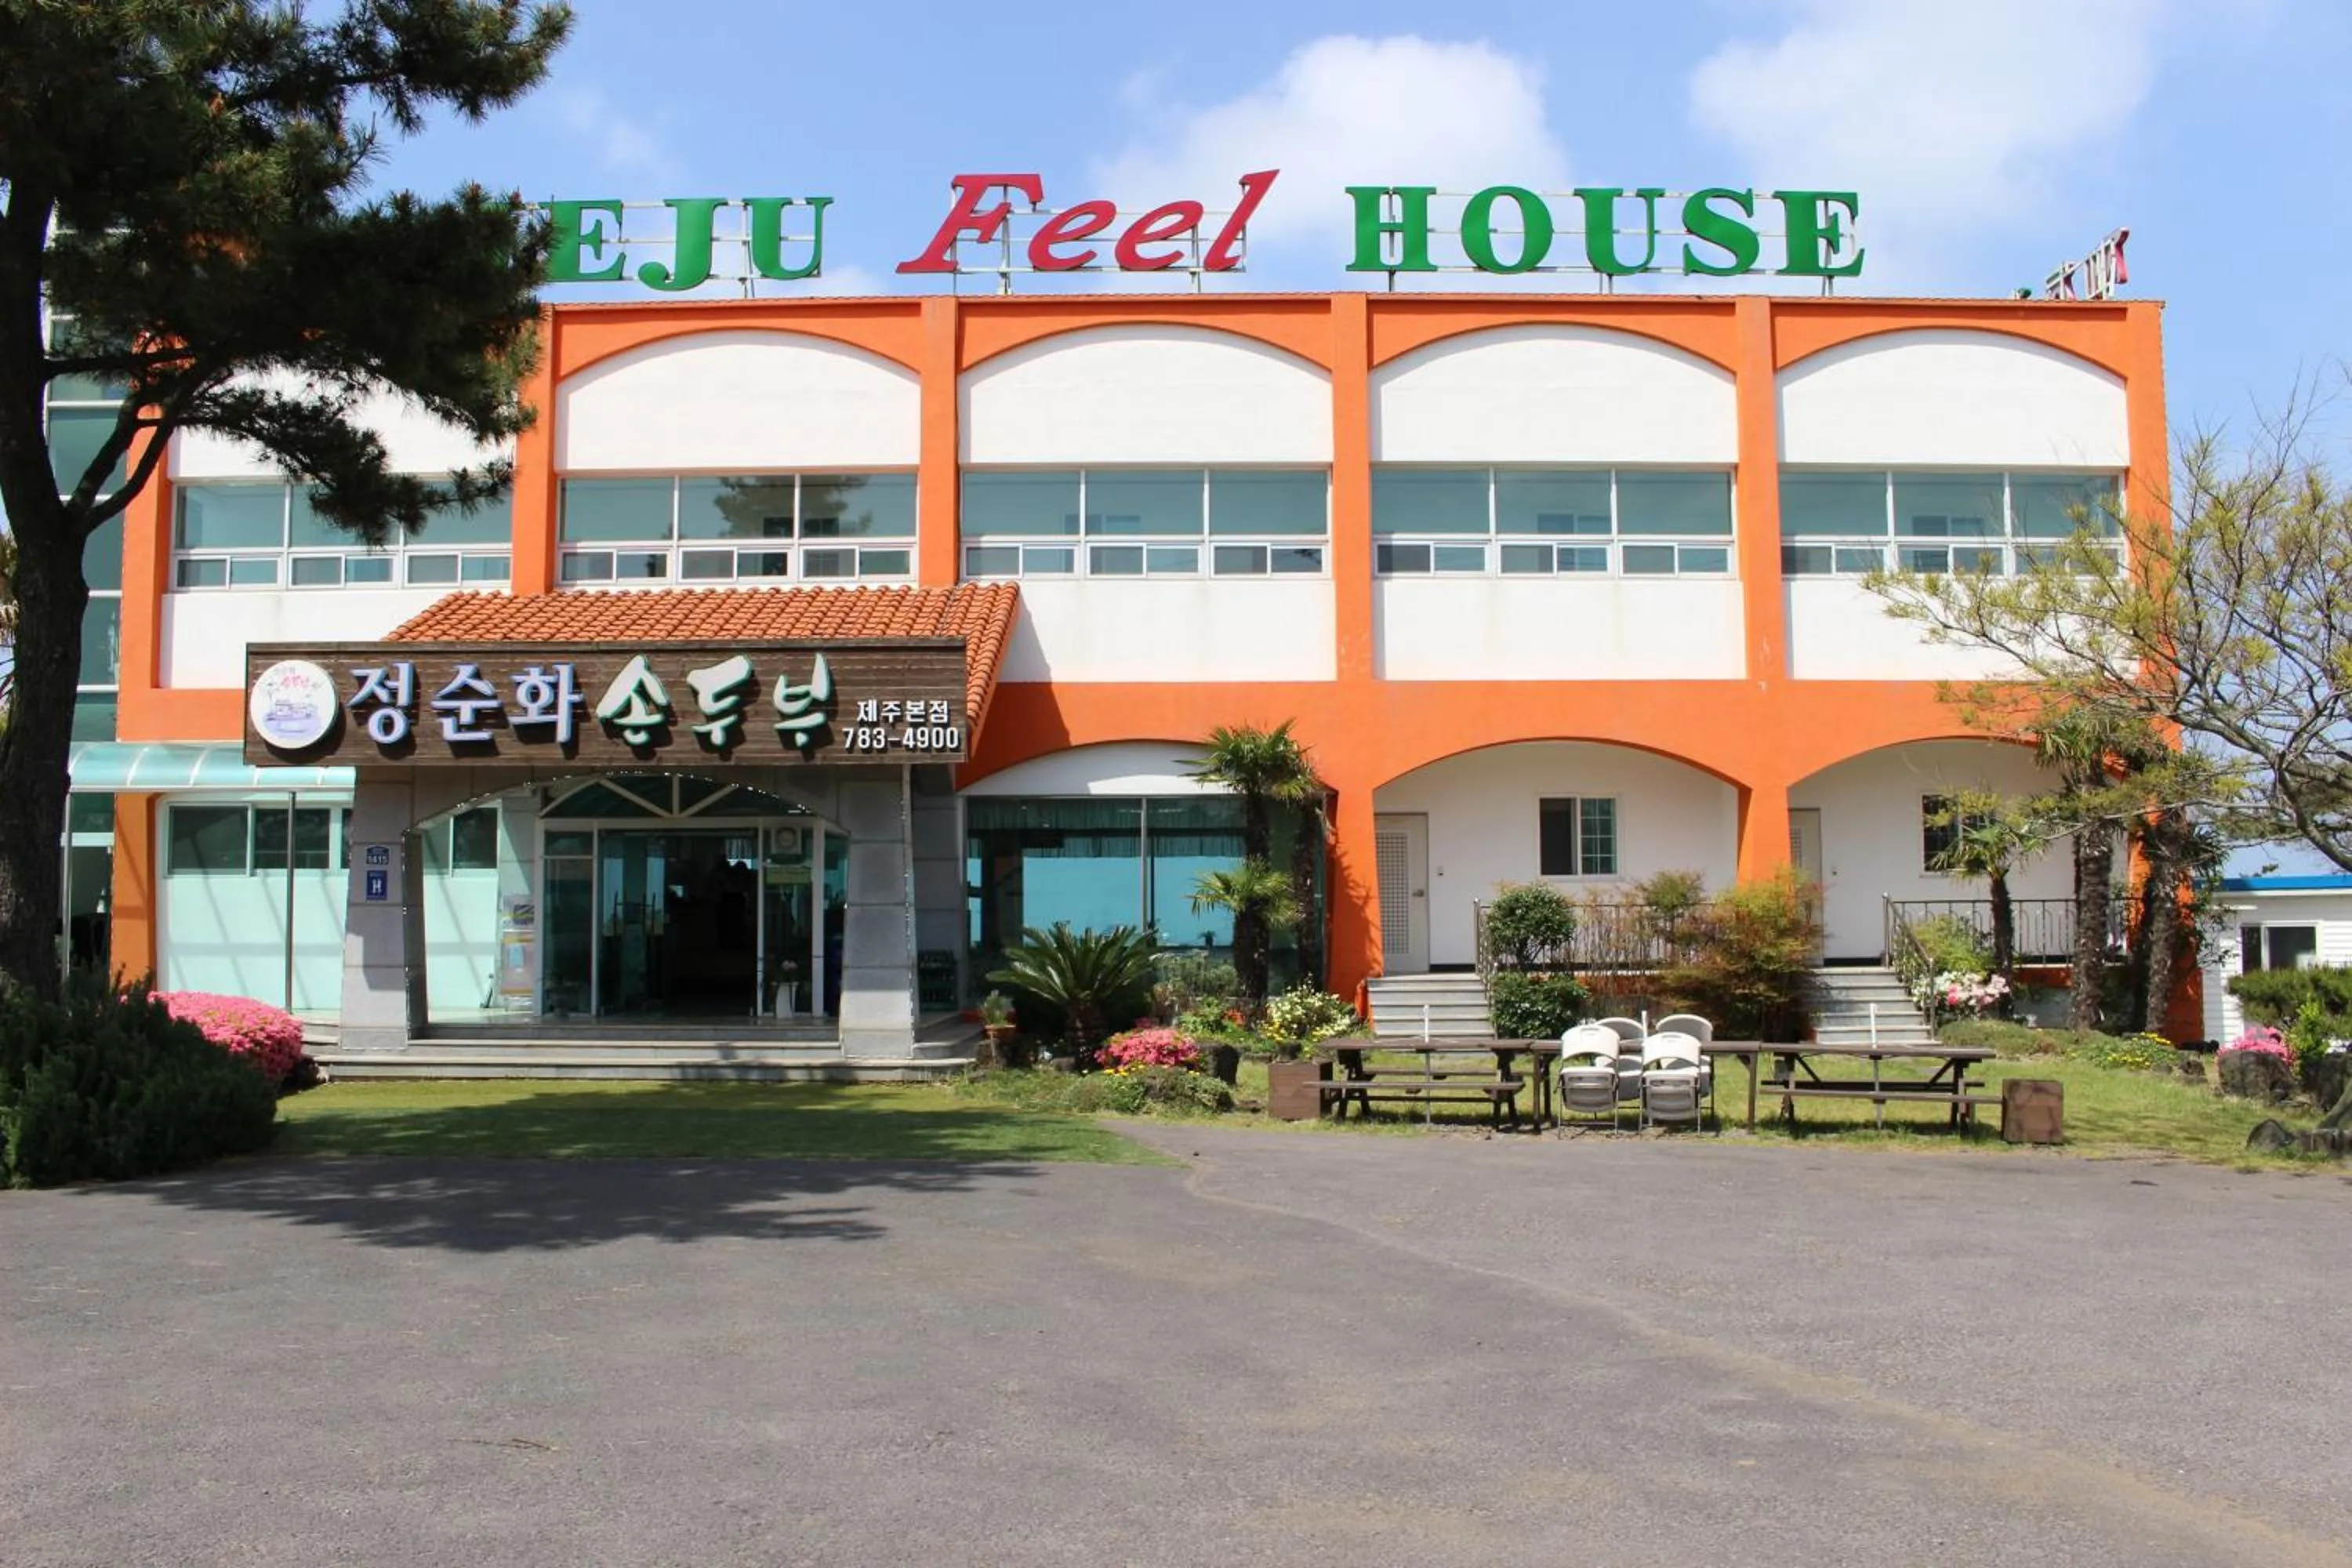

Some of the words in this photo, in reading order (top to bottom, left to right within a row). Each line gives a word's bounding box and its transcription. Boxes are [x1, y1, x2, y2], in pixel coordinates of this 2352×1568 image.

[480, 197, 834, 291] EJU
[895, 169, 1280, 274] Feel
[1345, 186, 1865, 277] HOUSE
[347, 661, 585, 745] 정순화
[595, 652, 832, 747] 손두부
[841, 726, 960, 750] 783-4900
